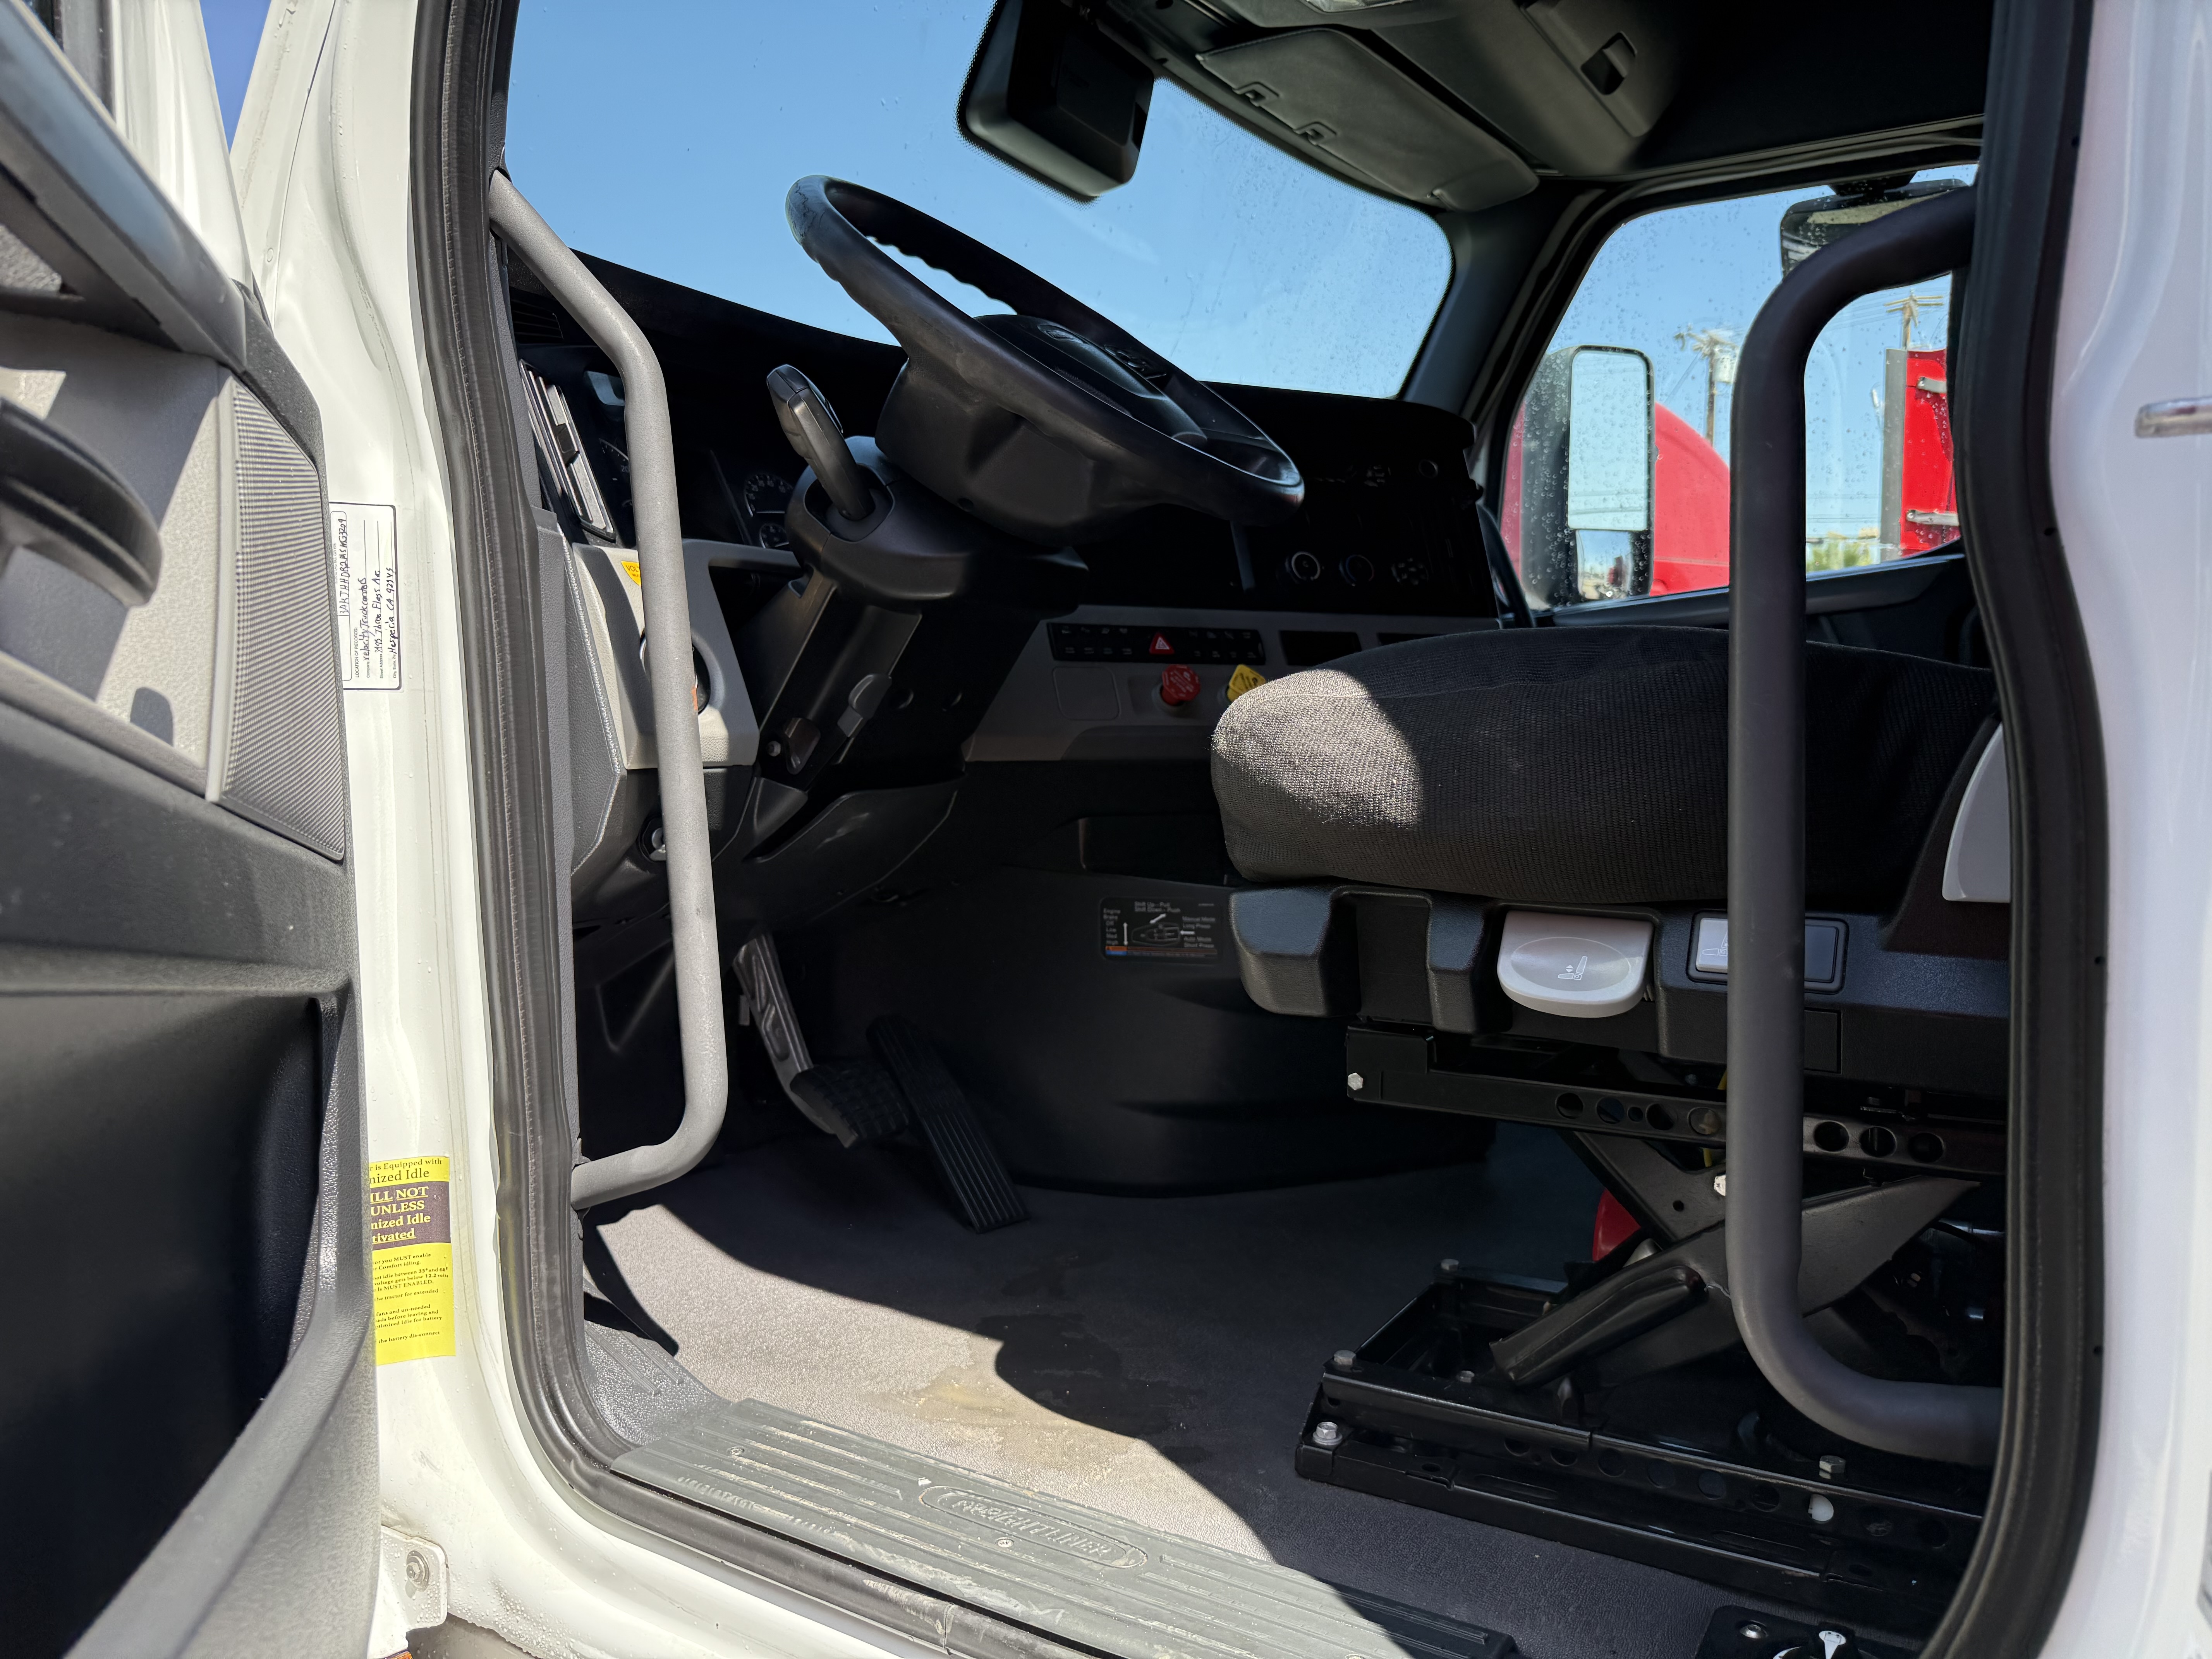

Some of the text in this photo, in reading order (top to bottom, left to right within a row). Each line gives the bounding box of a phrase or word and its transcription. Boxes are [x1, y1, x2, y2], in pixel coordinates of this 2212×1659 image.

[386, 599, 393, 610] CA
[384, 1159, 422, 1170] Equipped
[406, 1168, 429, 1180] Idle
[396, 1186, 429, 1199] NOT
[371, 1200, 425, 1216] UNLESS
[407, 1213, 431, 1225] Idle
